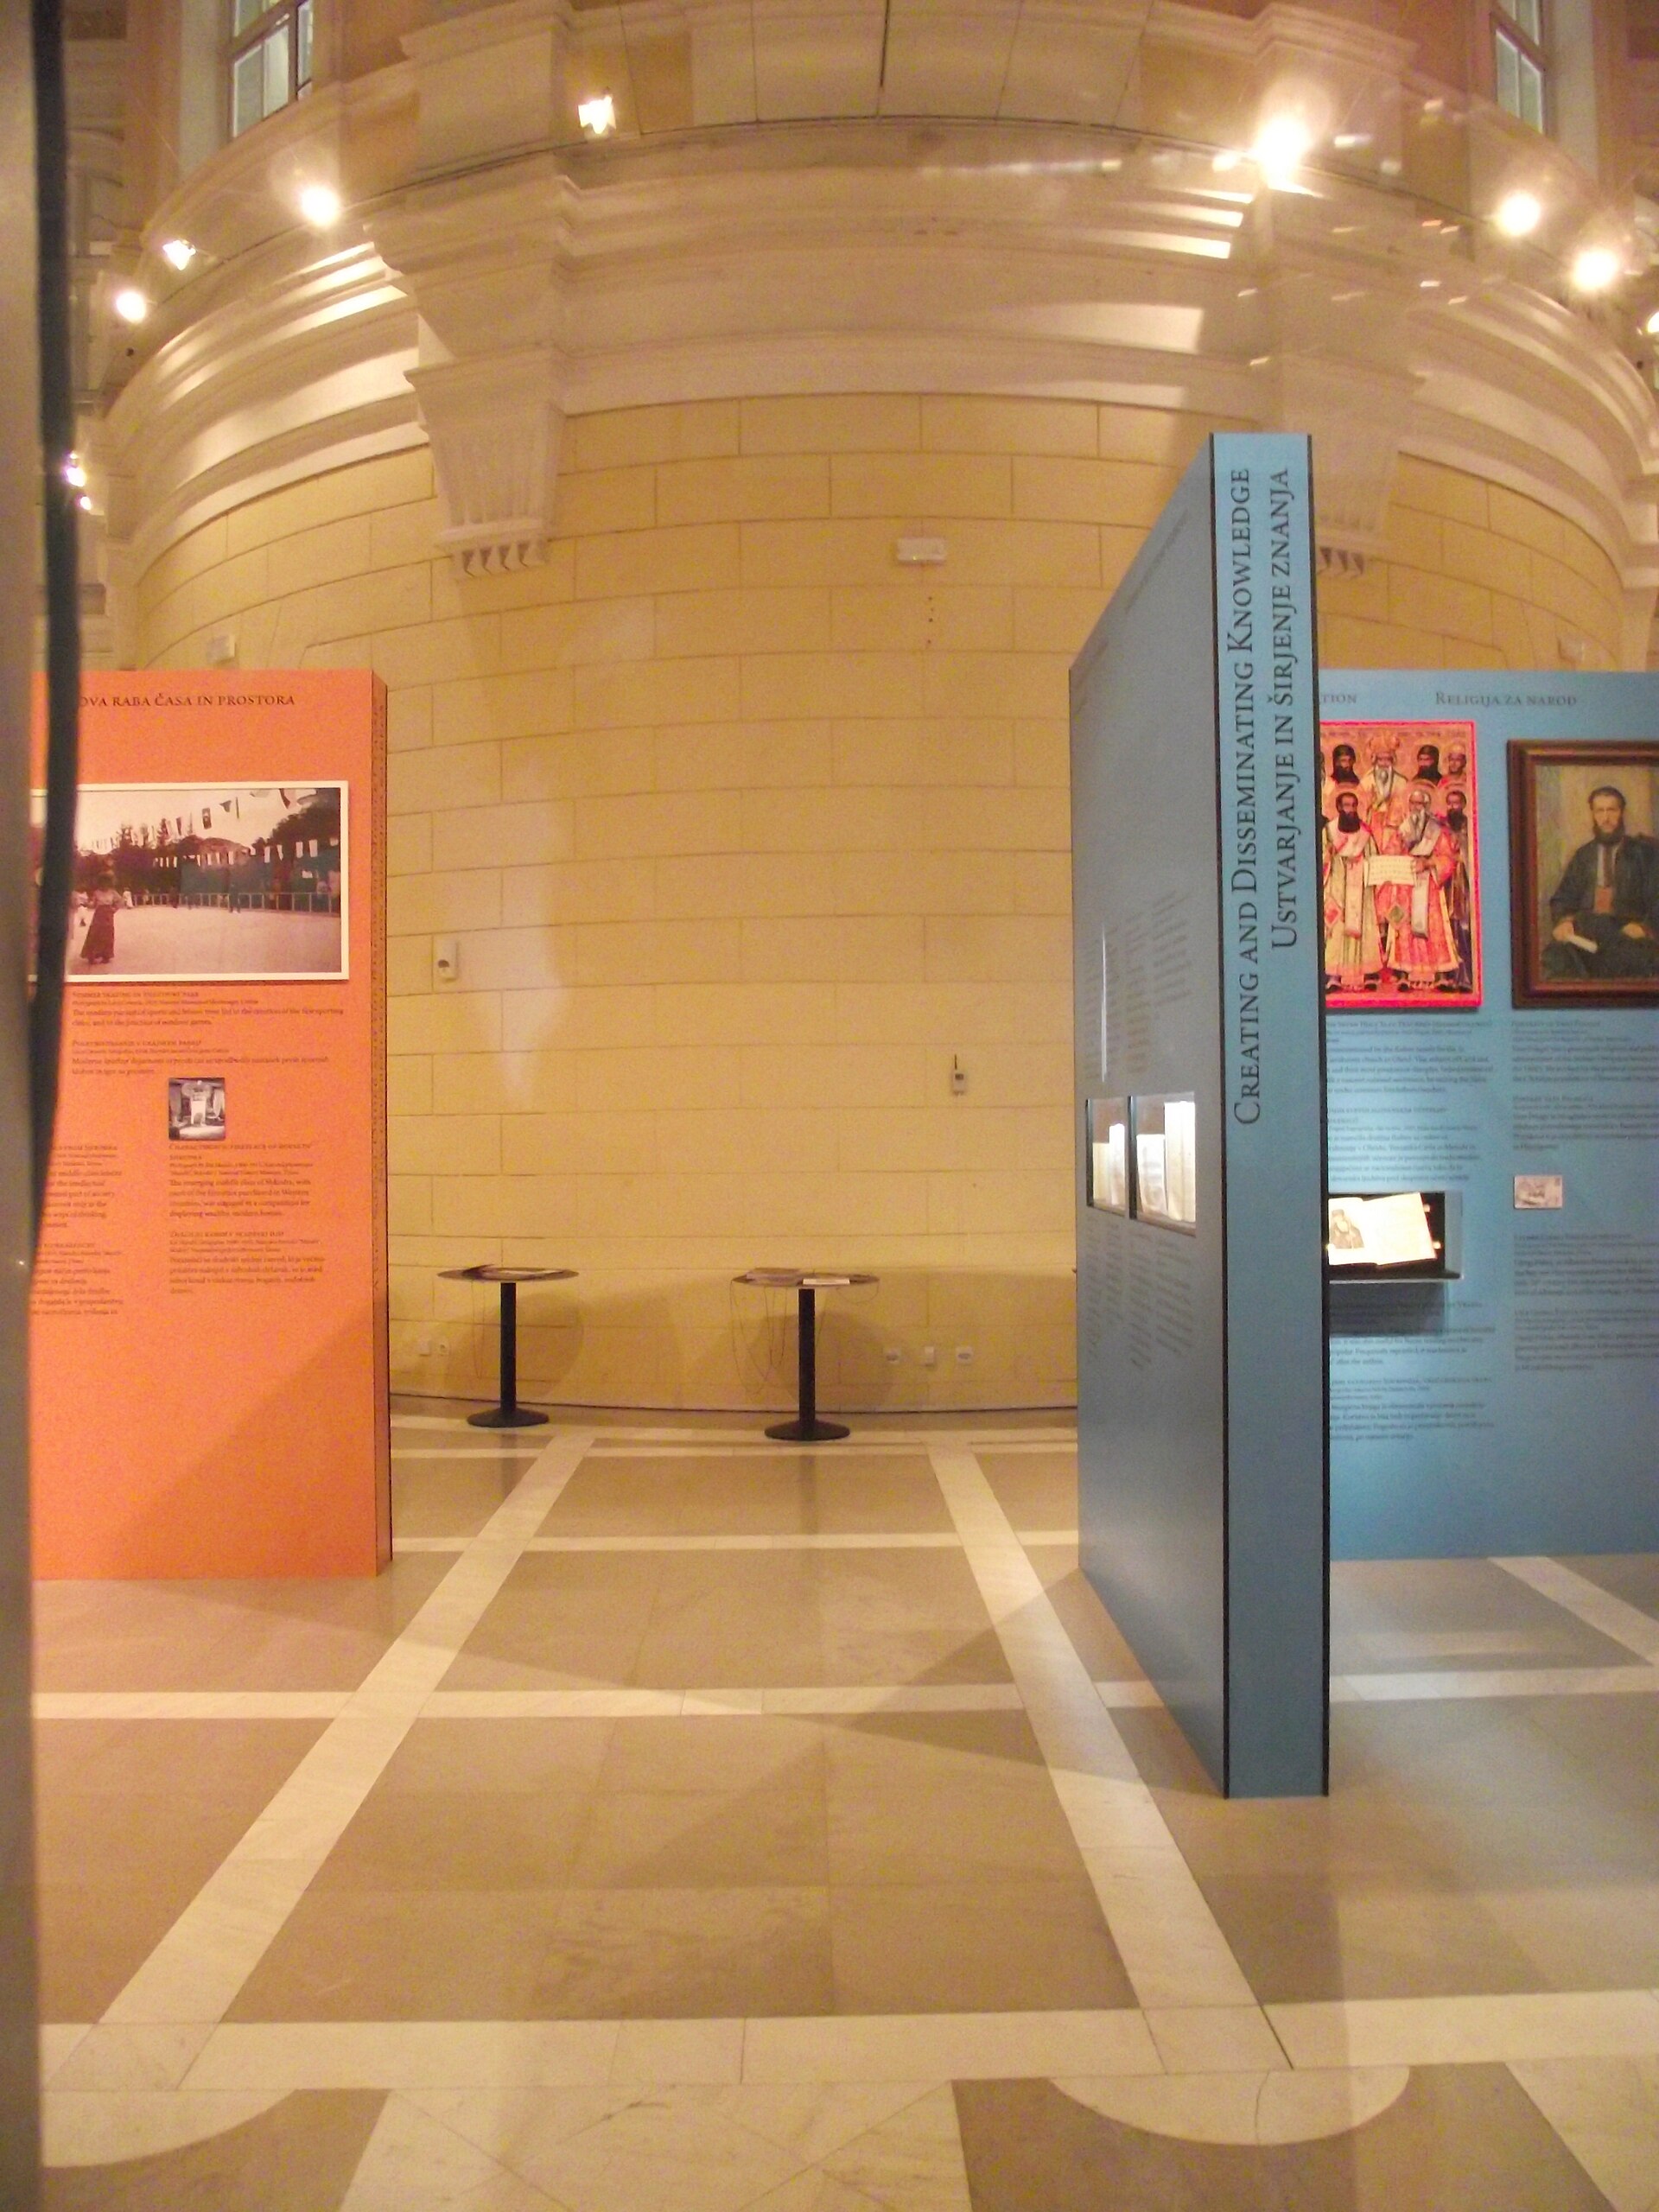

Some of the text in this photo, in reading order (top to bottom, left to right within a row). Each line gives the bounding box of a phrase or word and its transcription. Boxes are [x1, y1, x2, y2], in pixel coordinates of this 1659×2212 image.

[79, 693, 296, 707] OVA RABA ČASA IN PROSTORA
[1319, 694, 1357, 704] TION
[1435, 691, 1577, 708] RELIGIJA ZA NAROD
[1267, 469, 1301, 950] USTVARJANJE IN ŠIRJENJE ZNANJA
[1227, 468, 1261, 1125] CREATING AND DISSEMINATING KNOWLEDGE
